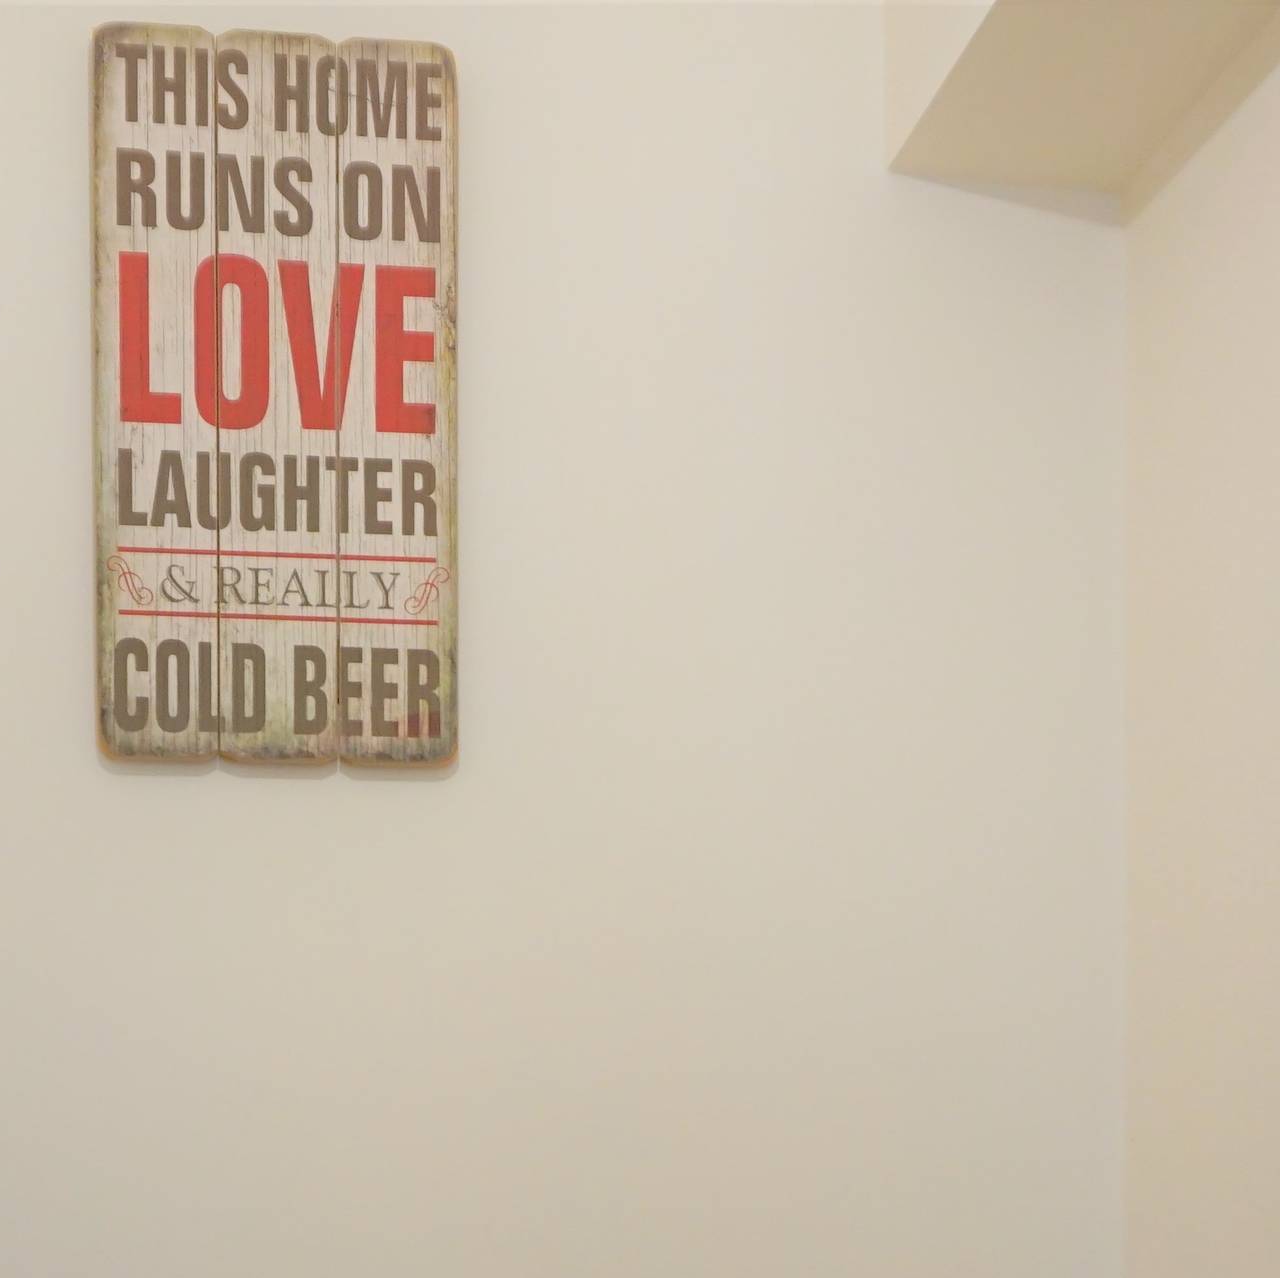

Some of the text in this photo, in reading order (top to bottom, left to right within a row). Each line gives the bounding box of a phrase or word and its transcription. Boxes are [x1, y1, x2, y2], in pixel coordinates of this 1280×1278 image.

[115, 42, 442, 141] THIS HOME
[115, 147, 441, 243] RUNS ON
[118, 250, 437, 435] LOVE
[117, 447, 439, 537] LAUGHTER
[159, 563, 401, 611] & REALLY
[113, 637, 442, 739] COLD BEER
